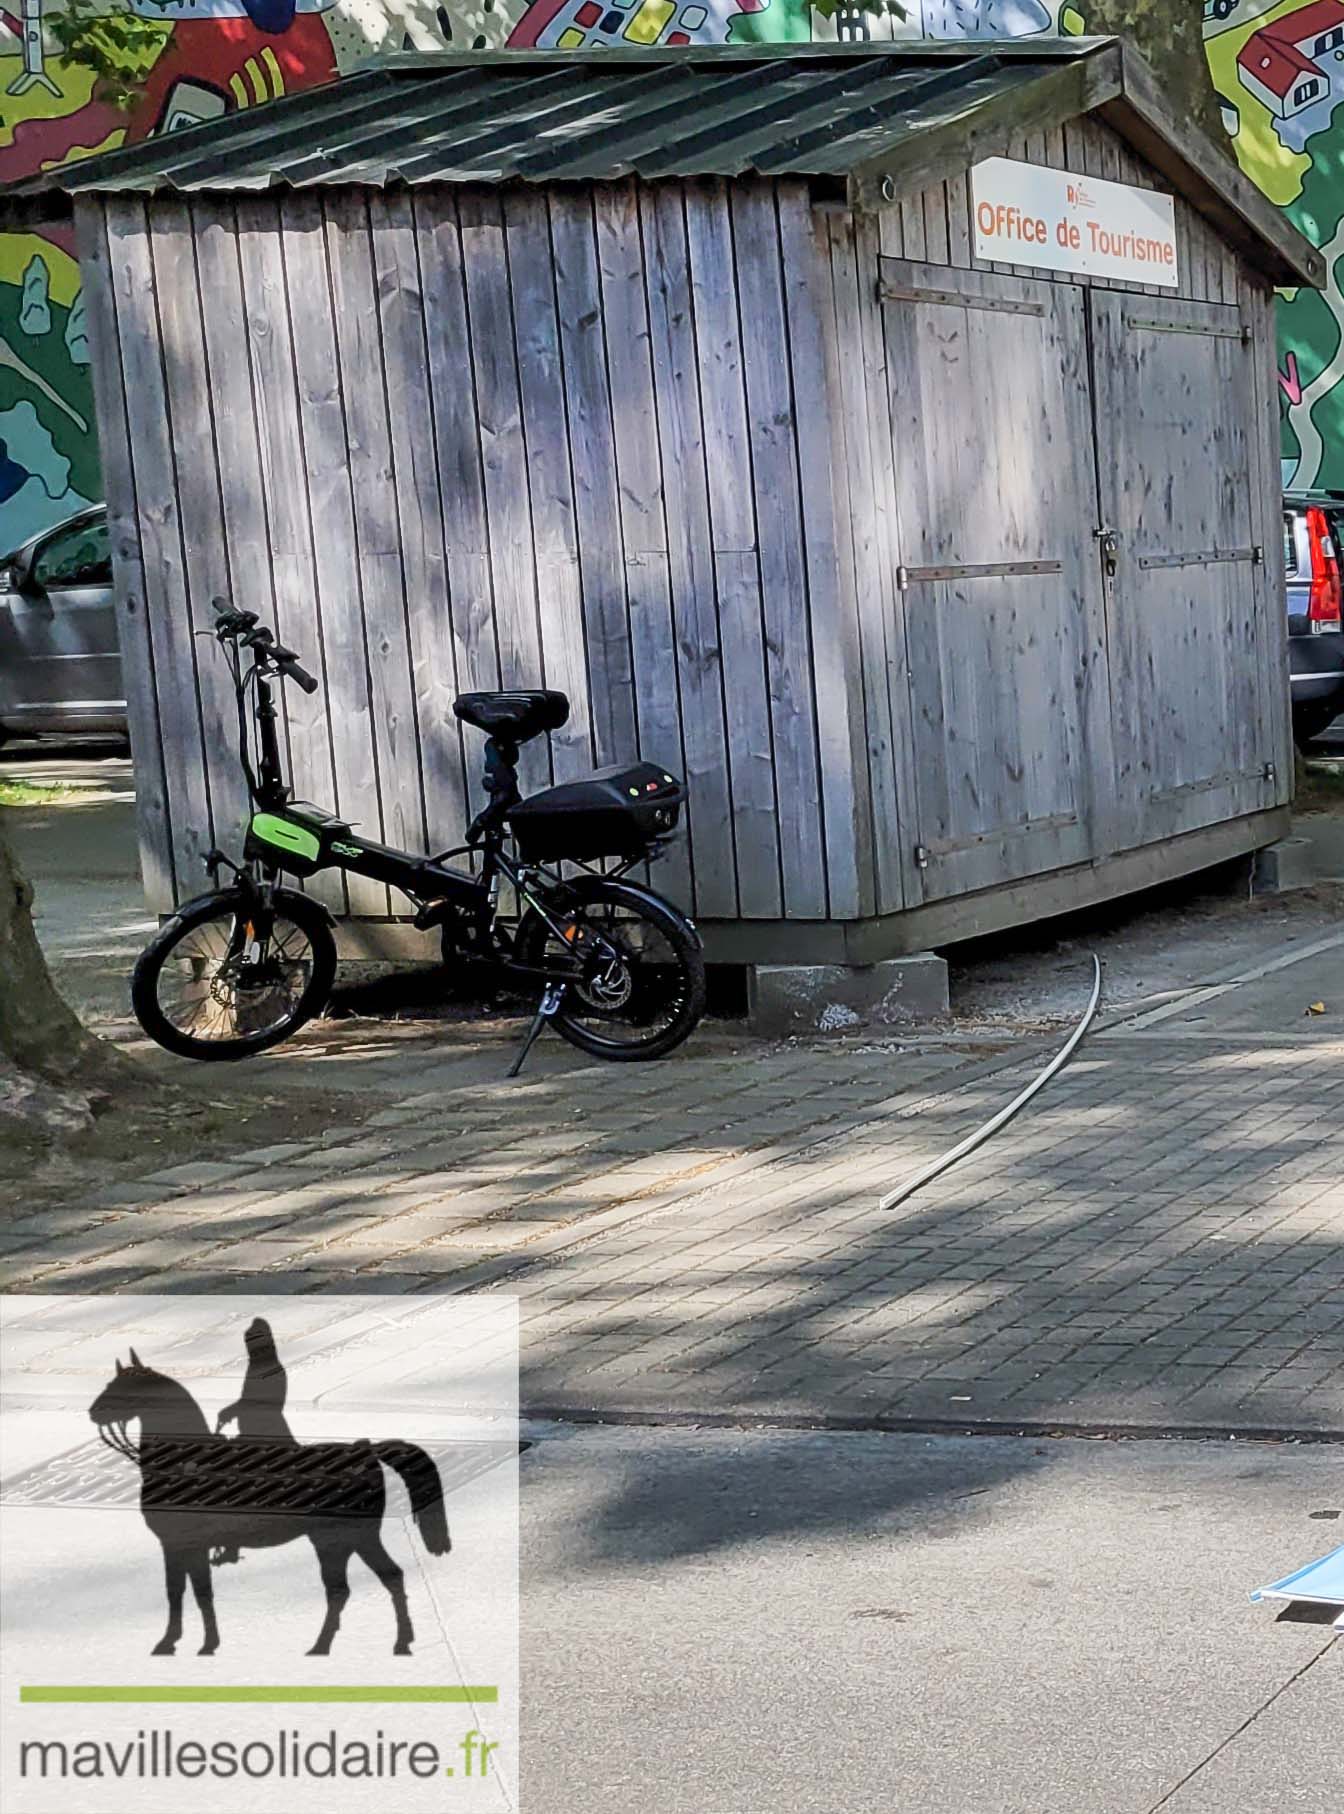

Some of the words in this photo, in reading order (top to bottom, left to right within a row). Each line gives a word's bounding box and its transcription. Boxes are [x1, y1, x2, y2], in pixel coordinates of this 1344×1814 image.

[977, 201, 1047, 245] Office
[1056, 216, 1080, 250] de
[1086, 221, 1174, 265] Tourisme
